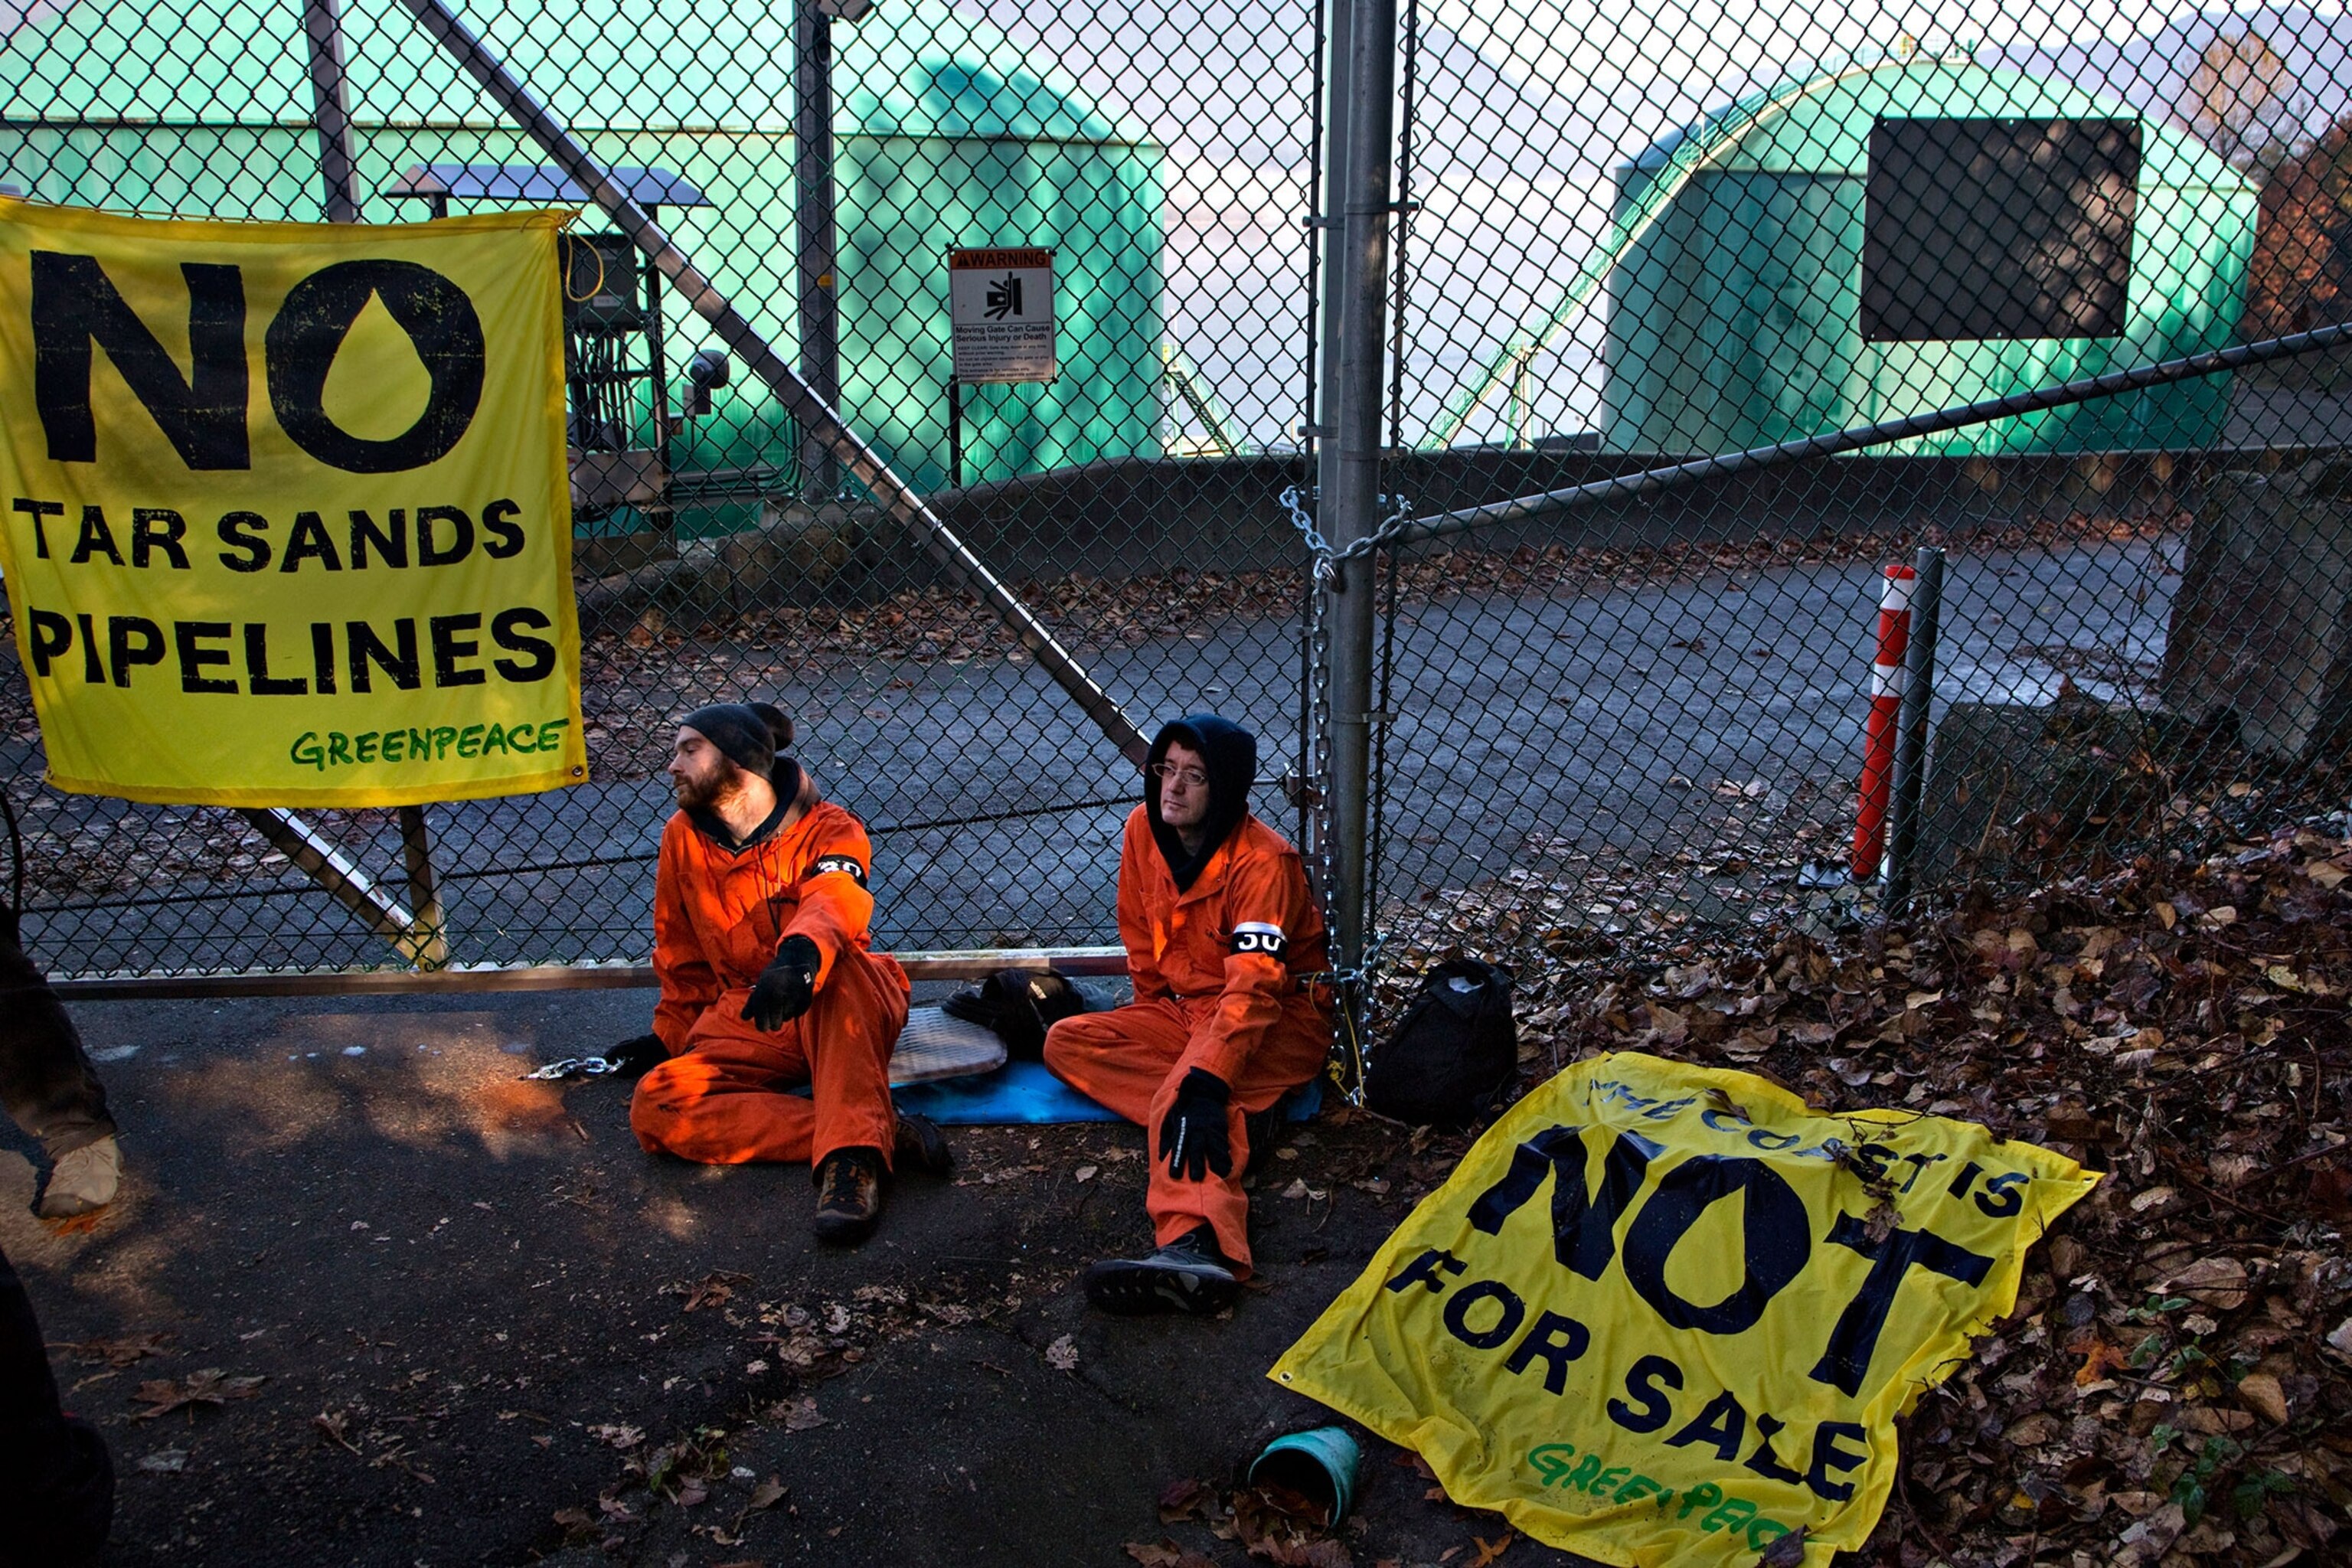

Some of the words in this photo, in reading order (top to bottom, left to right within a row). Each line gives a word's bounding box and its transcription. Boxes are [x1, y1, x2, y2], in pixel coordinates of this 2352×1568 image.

[971, 251, 1046, 267] WARNING
[31, 250, 485, 474] NO
[988, 335, 1011, 343] Injury
[12, 498, 191, 570] TAR
[217, 498, 525, 573] SANDS
[28, 606, 557, 695] PIPELINES
[291, 717, 570, 771] GREENPEACE
[1583, 1079, 1697, 1120] THE
[1948, 1161, 2030, 1217] IS
[1467, 1125, 1994, 1398] NOT
[1385, 1248, 1590, 1395] FOR
[1608, 1354, 1868, 1501] SALE
